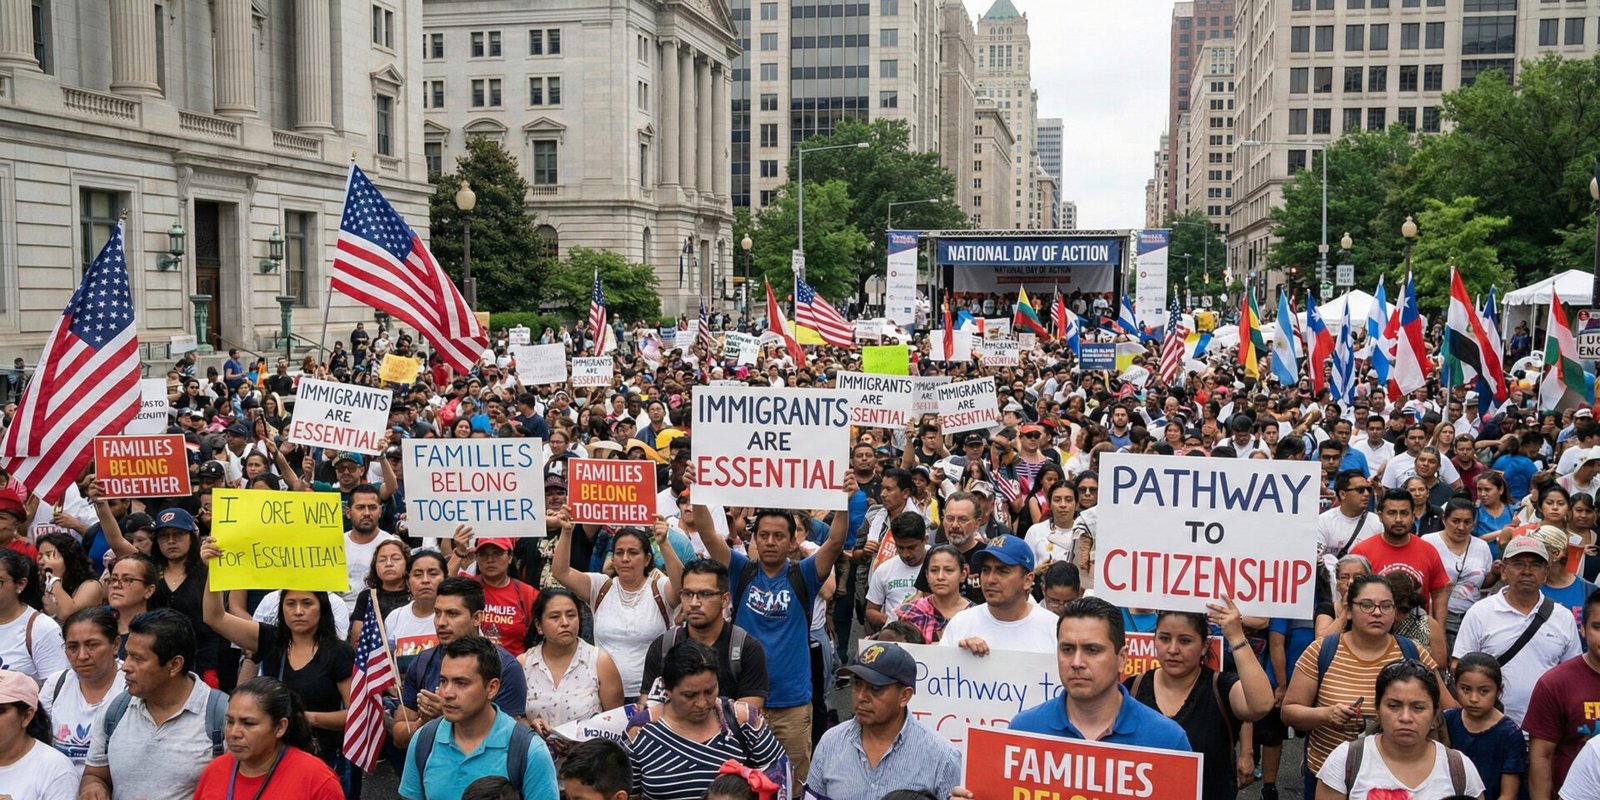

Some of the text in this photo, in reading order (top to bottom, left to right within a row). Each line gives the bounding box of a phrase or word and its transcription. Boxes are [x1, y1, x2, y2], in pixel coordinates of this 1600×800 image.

[948, 245, 1108, 261] NATIONAL DAY OF ACTION
[573, 358, 612, 367] IMMIGRANTS
[573, 376, 613, 384] ESSENTIAL
[839, 375, 912, 393] IMMIGRANTS
[300, 383, 389, 411] IMMIGRANTS
[860, 394, 883, 405] ARE
[938, 380, 995, 401] IMMIGRANTS
[699, 394, 848, 427] IMMIGRANTS
[957, 399, 975, 410] ARE
[325, 409, 352, 423] ARE
[850, 407, 908, 426] SENTIAL
[943, 408, 997, 429] ESSENTIAL
[293, 420, 380, 451] ESSENTIAL
[747, 431, 791, 451] ARE
[102, 439, 173, 457] FAMILIES
[414, 443, 533, 468] FAMILIES
[109, 458, 168, 476] BELONG
[575, 463, 643, 482] FAMILIES
[697, 456, 844, 490] ESSENTIAL
[100, 476, 181, 495] TOGETHER
[431, 472, 517, 492] BELONG
[1112, 465, 1312, 514] PATHWAY
[581, 483, 637, 502] BELONG
[219, 496, 339, 525] I ORE WAY
[412, 498, 536, 522] TOGETHER
[573, 502, 648, 521] TOGETHER
[1185, 521, 1224, 544] TO
[1103, 549, 1312, 604] CITIZENSHIP
[913, 661, 1027, 713] Pathway
[1003, 744, 1153, 798] FAMILIES
